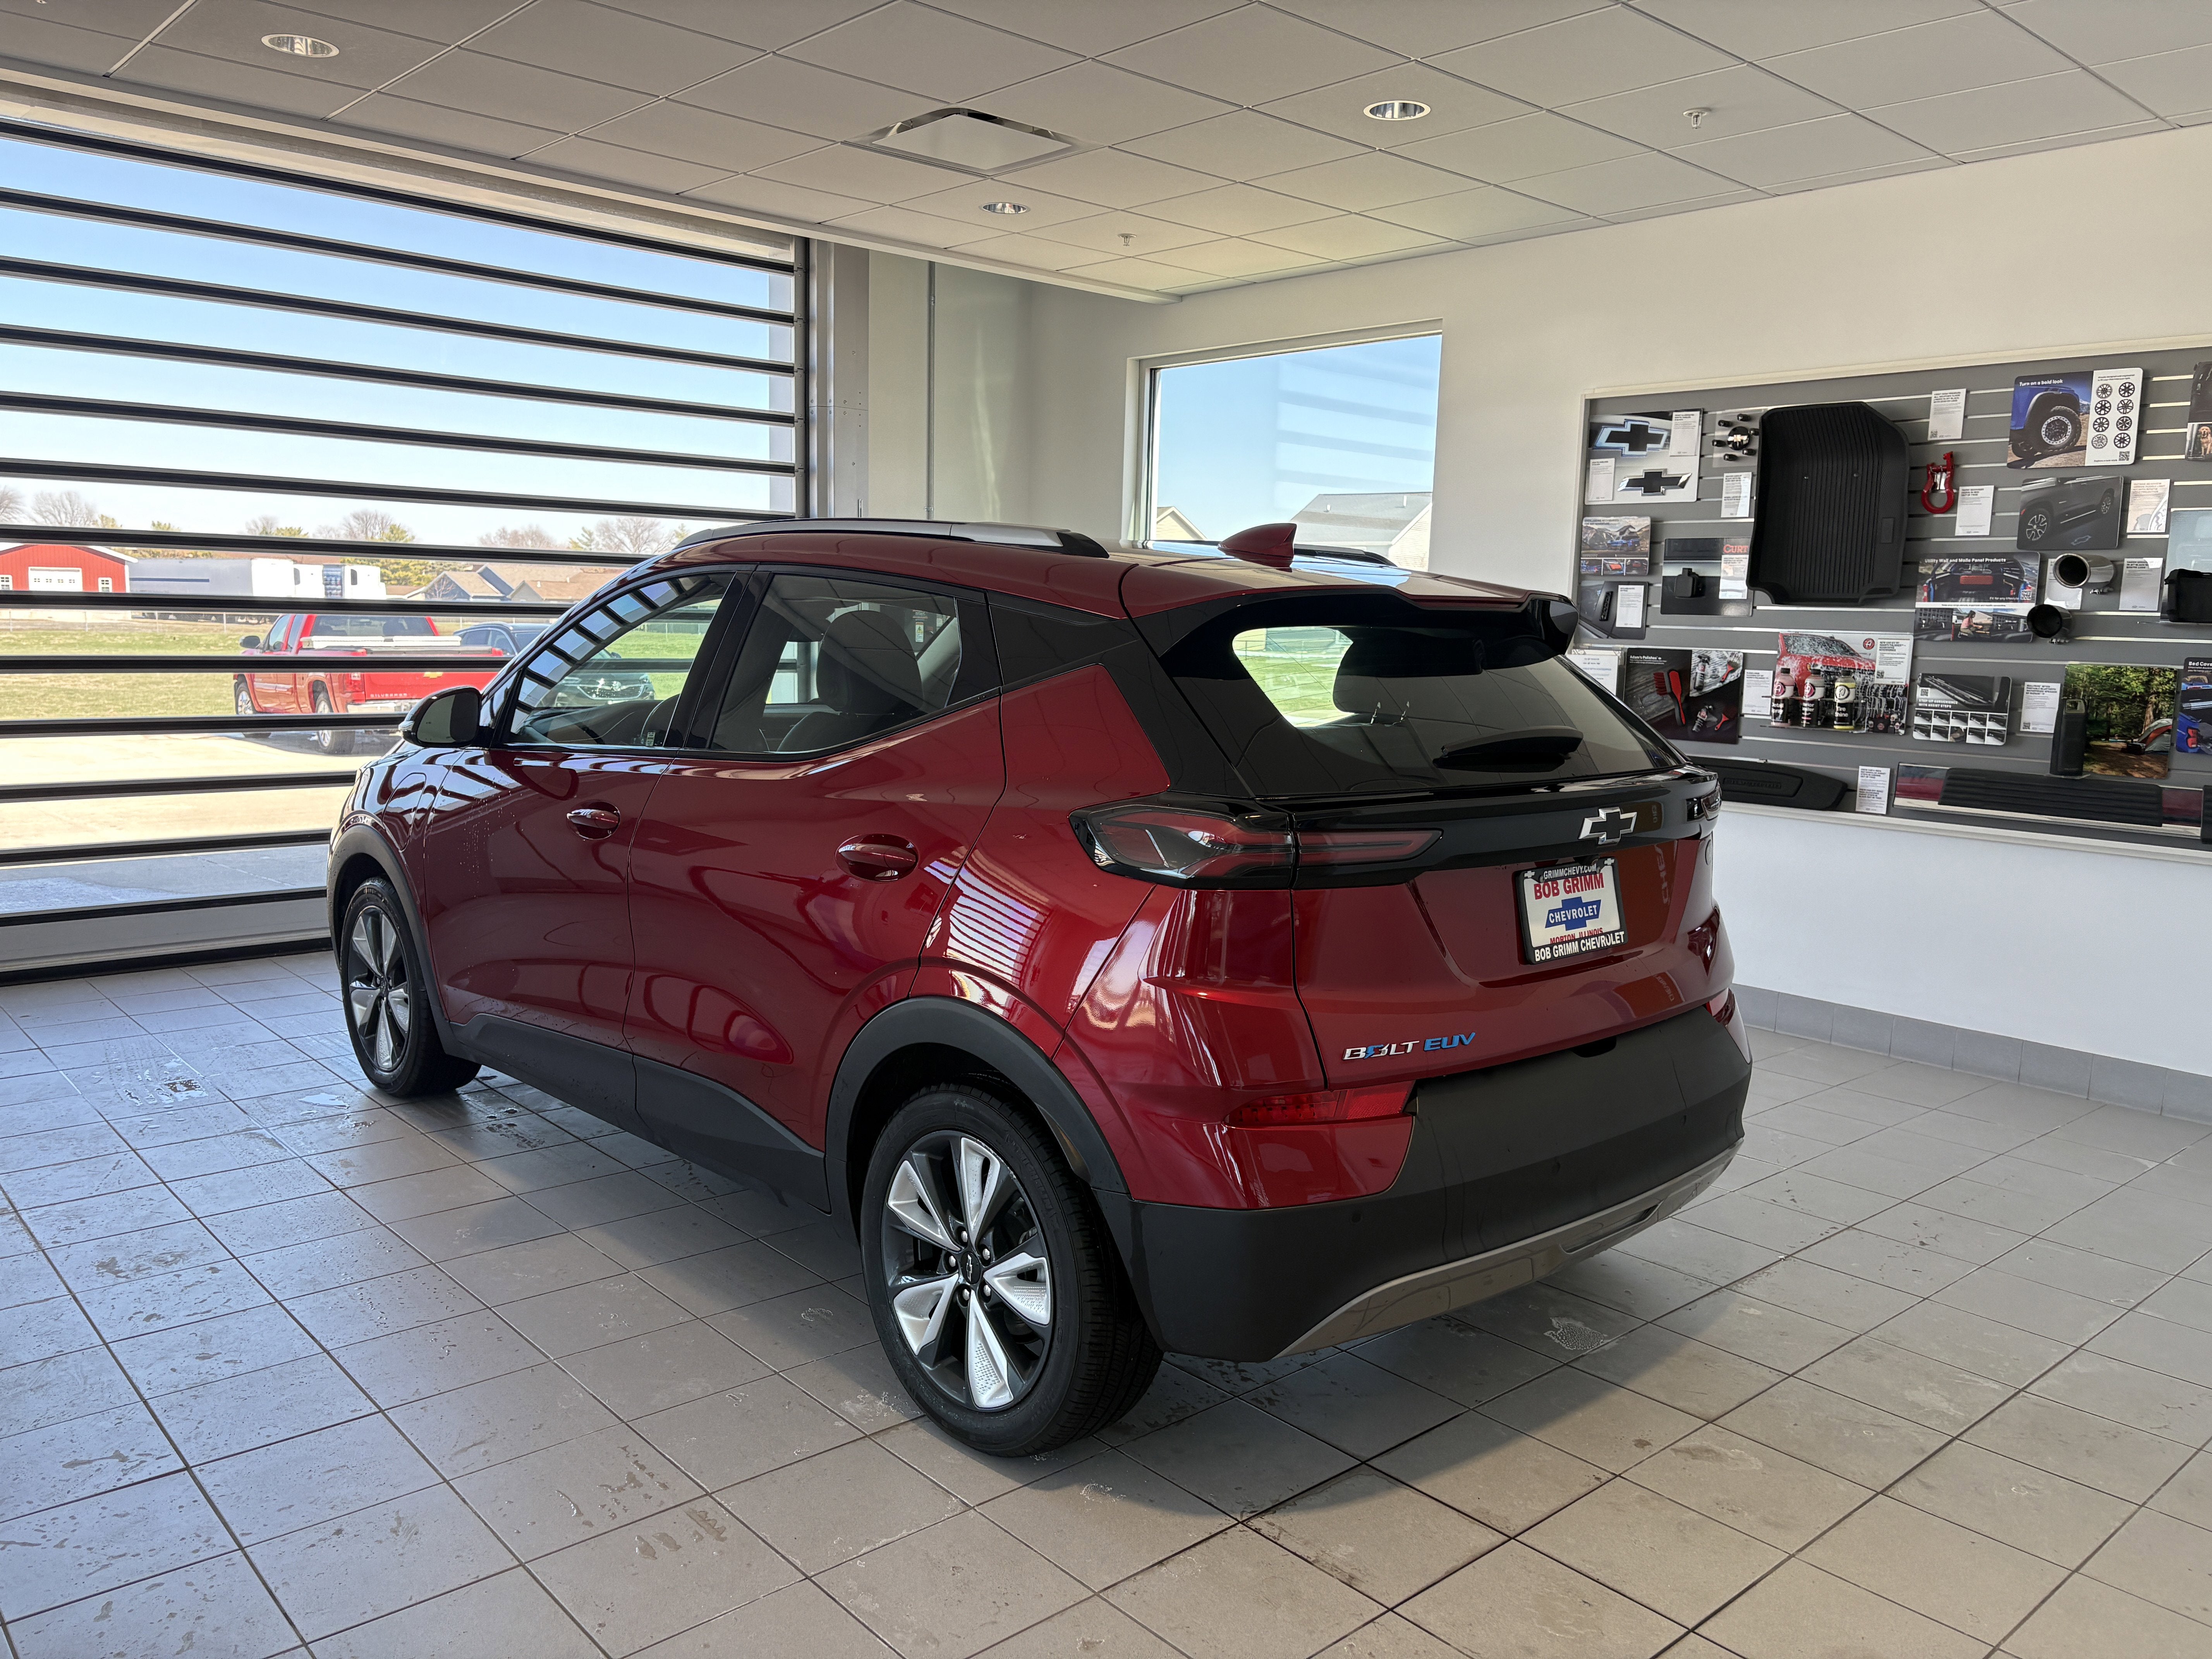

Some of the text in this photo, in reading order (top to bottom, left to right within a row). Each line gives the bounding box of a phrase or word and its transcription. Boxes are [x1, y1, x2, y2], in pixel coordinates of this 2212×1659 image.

[1544, 863, 1597, 879] GRIMMCHEVY.COM
[1534, 873, 1604, 900] BOB GRIMM
[1549, 905, 1597, 923] CHEVROLET
[1535, 931, 1625, 962] BOB GRIMM CHEVROLET
[1550, 927, 1603, 944] MORTON ILLINOIS
[1342, 1032, 1476, 1060] BOLT EUV
